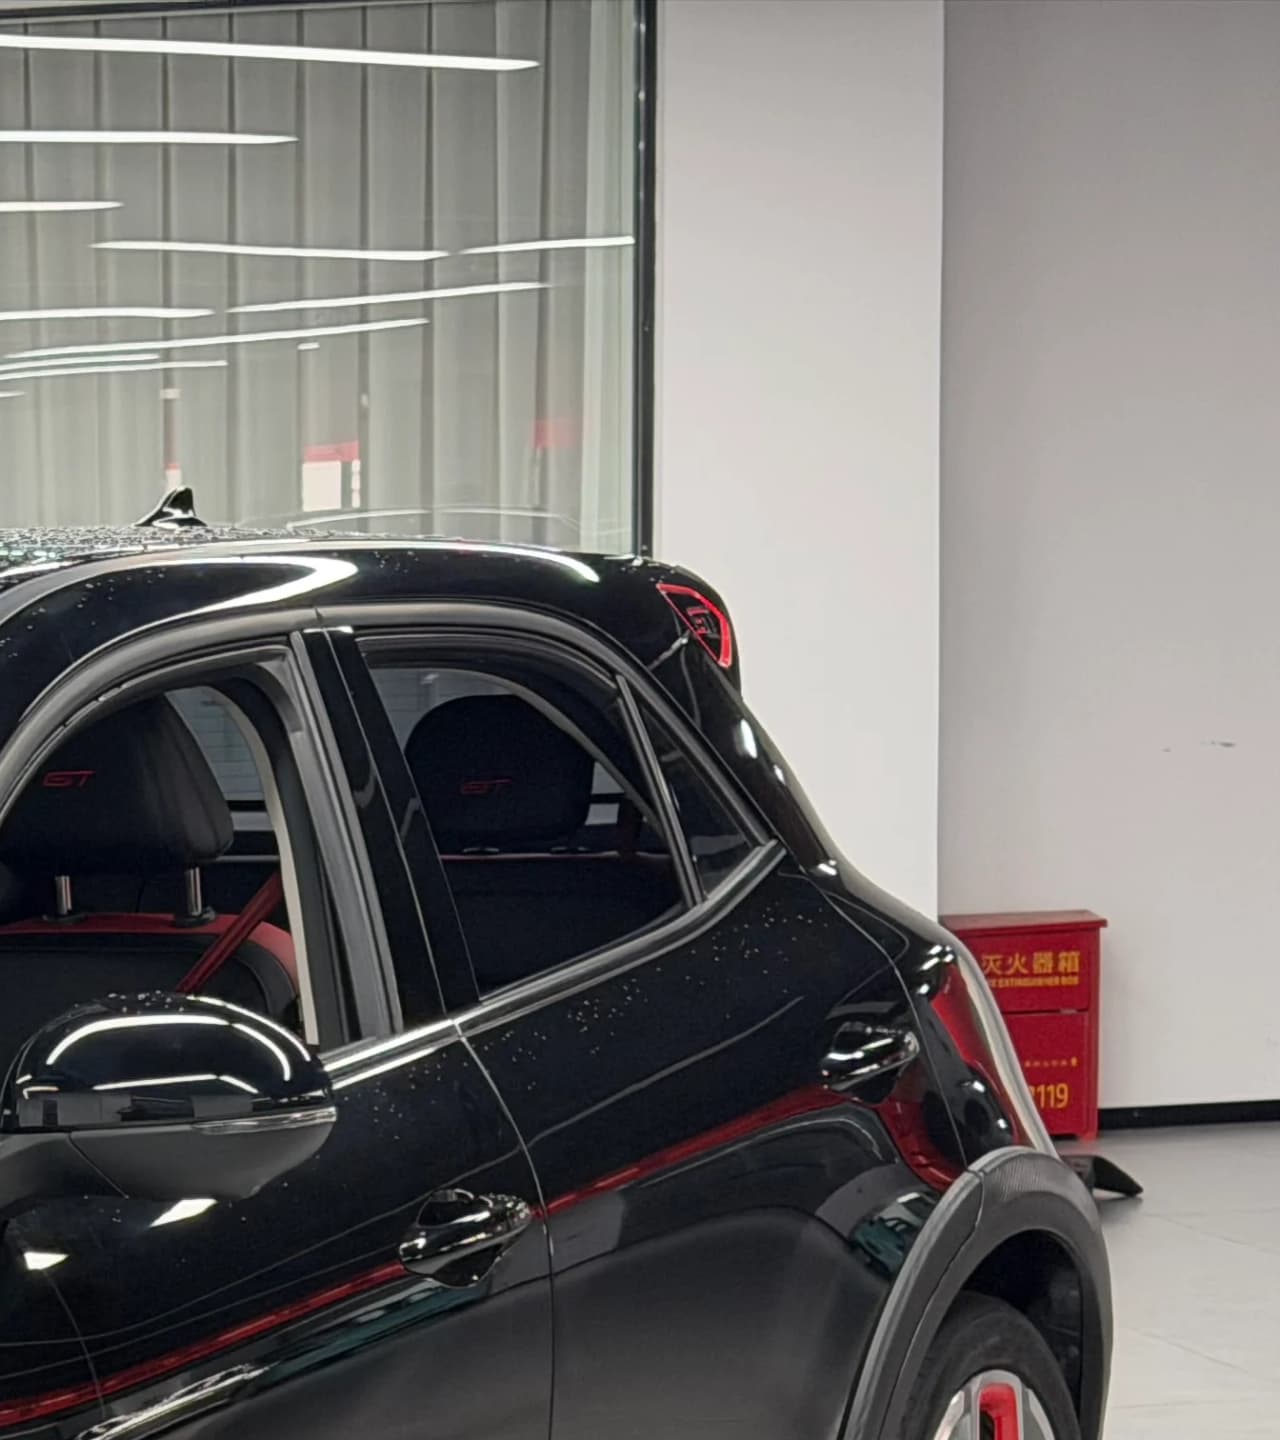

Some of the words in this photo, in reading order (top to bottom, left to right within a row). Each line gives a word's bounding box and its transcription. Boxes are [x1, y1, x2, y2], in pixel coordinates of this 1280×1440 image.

[43, 769, 95, 788] GT
[981, 951, 1080, 975] 灭火器箱
